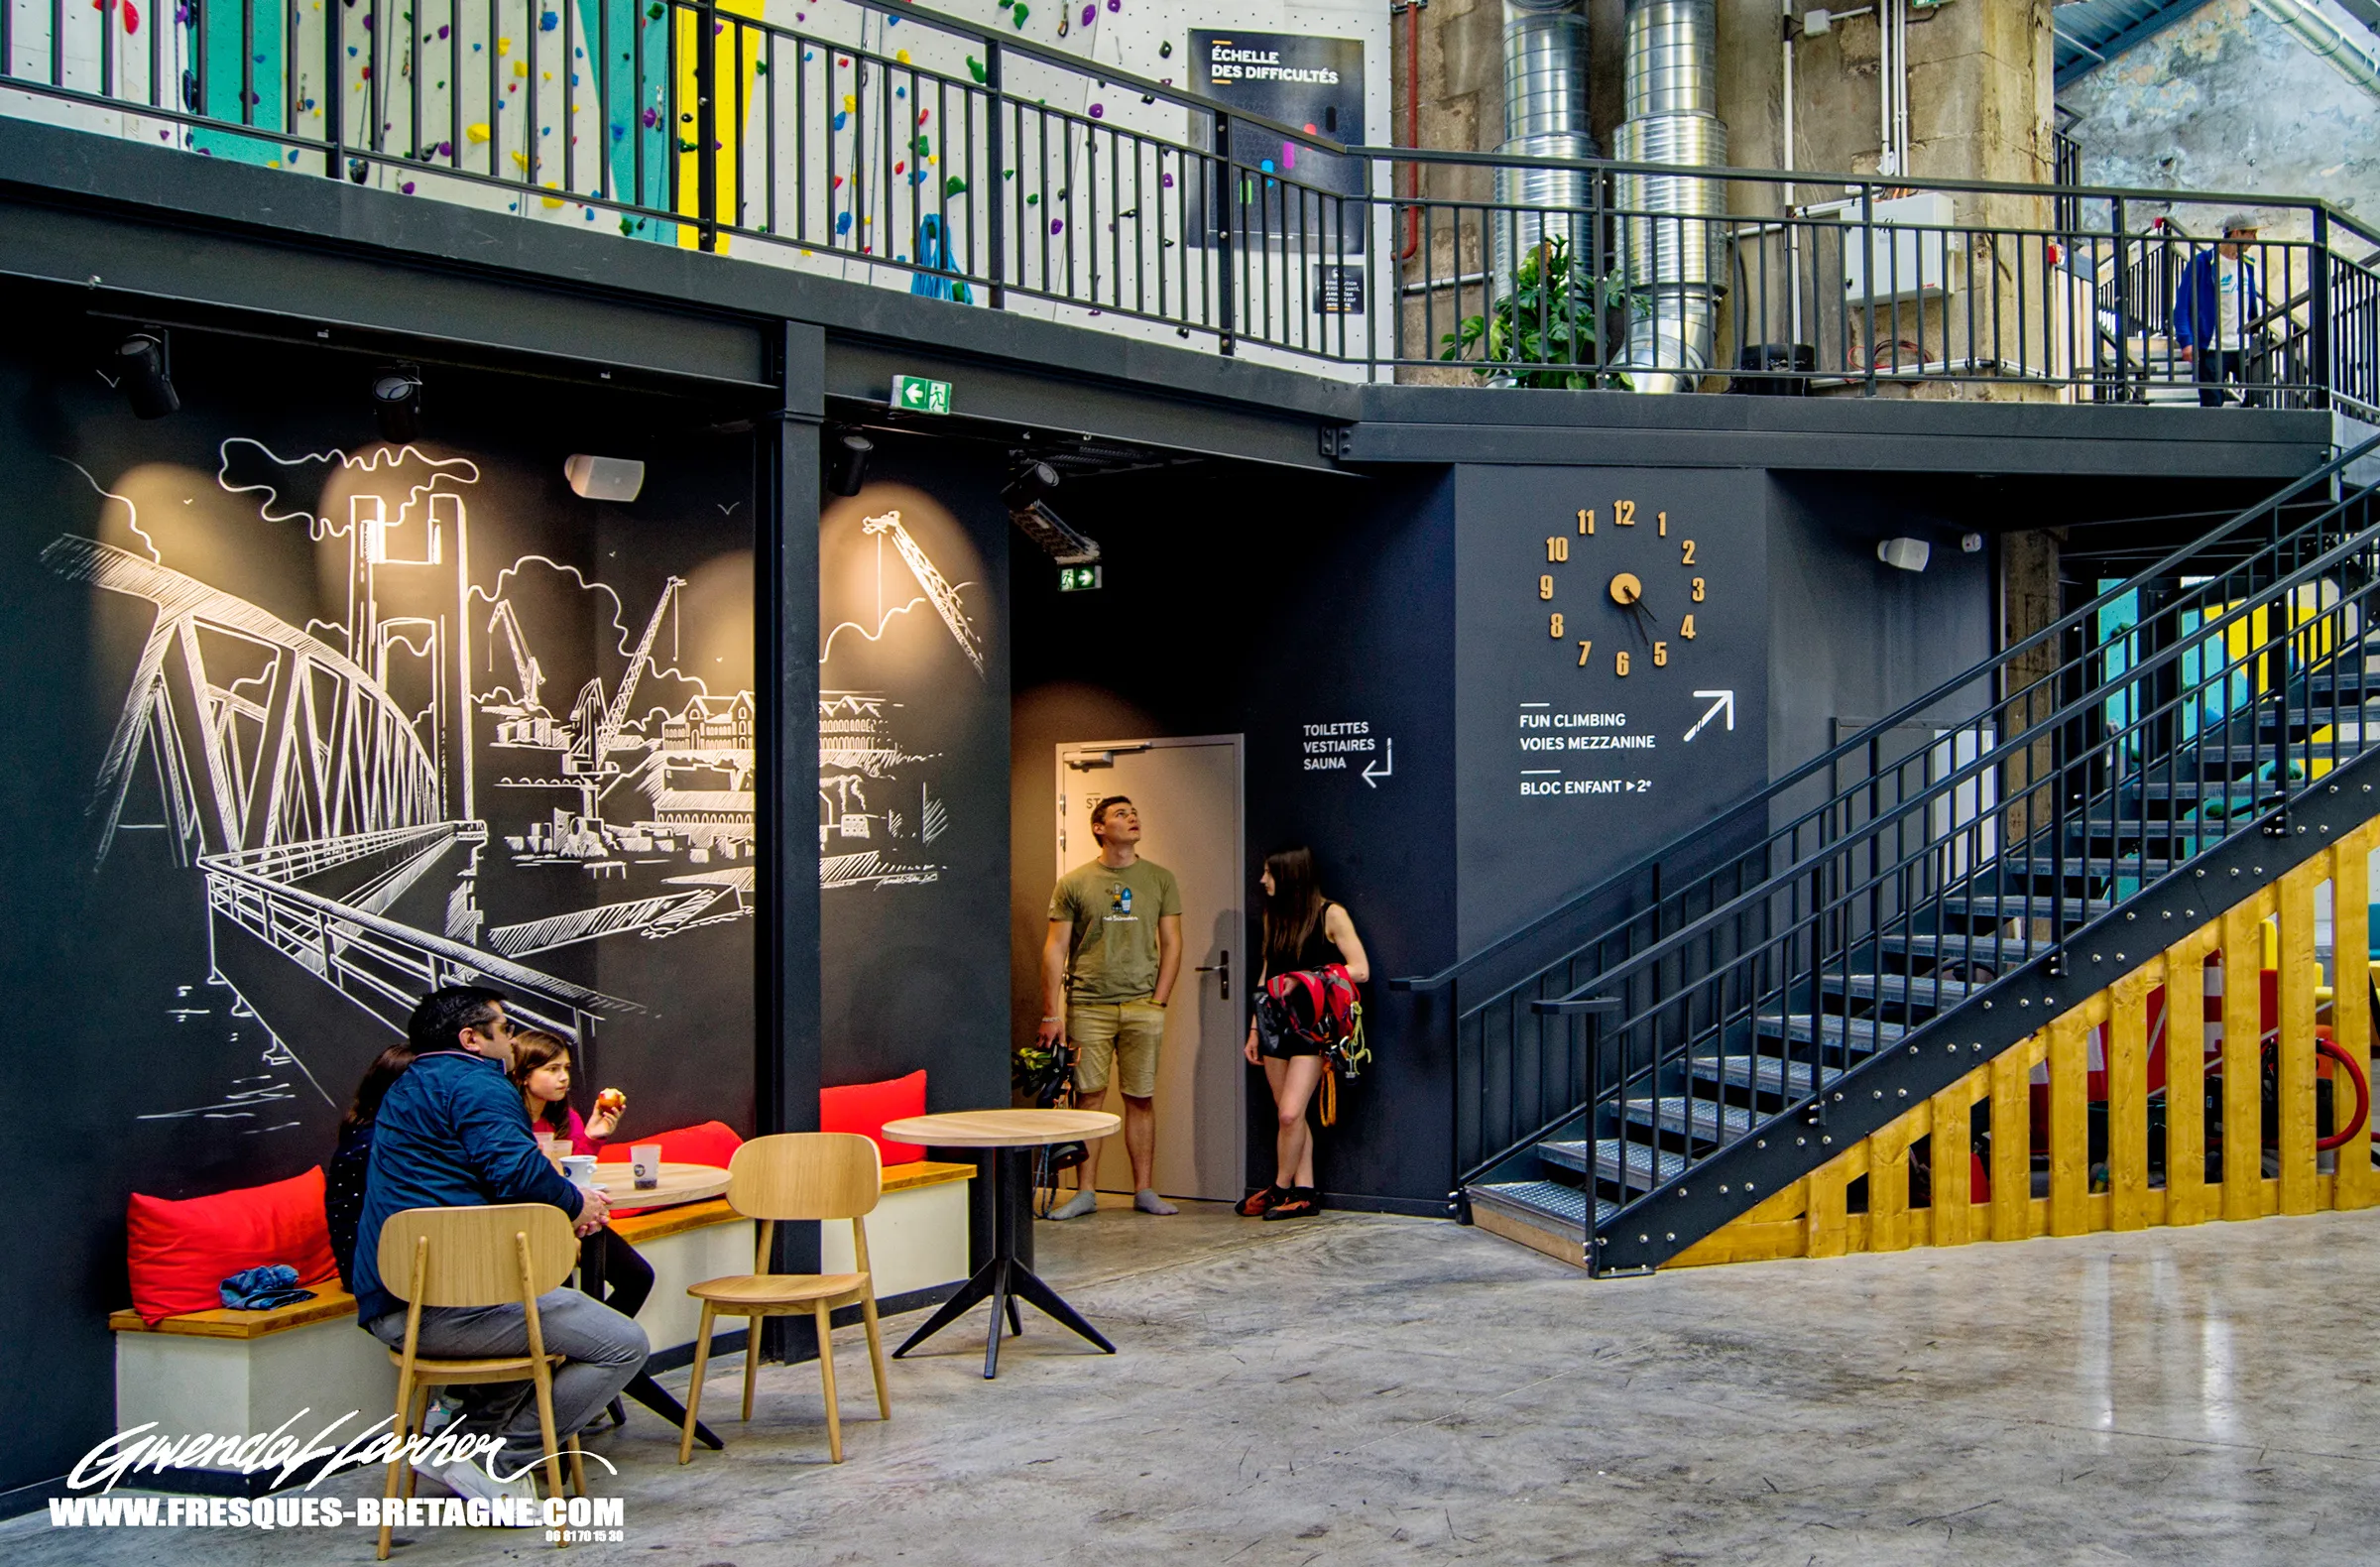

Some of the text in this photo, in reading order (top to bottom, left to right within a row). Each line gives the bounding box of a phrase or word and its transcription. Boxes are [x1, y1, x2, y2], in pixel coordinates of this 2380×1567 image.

[1212, 46, 1279, 64] ÉCHELLE
[1212, 63, 1339, 84] DES DIFFICULTÉS
[1577, 509, 1595, 535] 11
[1613, 499, 1635, 526] 12
[1657, 511, 1667, 537] 1
[1546, 537, 1569, 562] 10
[1682, 540, 1696, 564] 2
[1539, 574, 1553, 600] 9
[1691, 576, 1706, 603] 3
[1550, 612, 1564, 639] 8
[1680, 614, 1697, 640] 4
[1578, 641, 1592, 666] 7
[1615, 651, 1630, 676] 6
[1653, 641, 1667, 666] 5
[1303, 721, 1369, 737] TOILETTES
[1519, 713, 1626, 728] FUN CLIMBING
[1303, 739, 1375, 754] VESTIAIRES
[1519, 735, 1656, 751] VOIES MEZZANINE
[1303, 757, 1347, 771] SAUNA
[1520, 782, 1562, 795] BLOC
[1564, 780, 1621, 794] ENFANT
